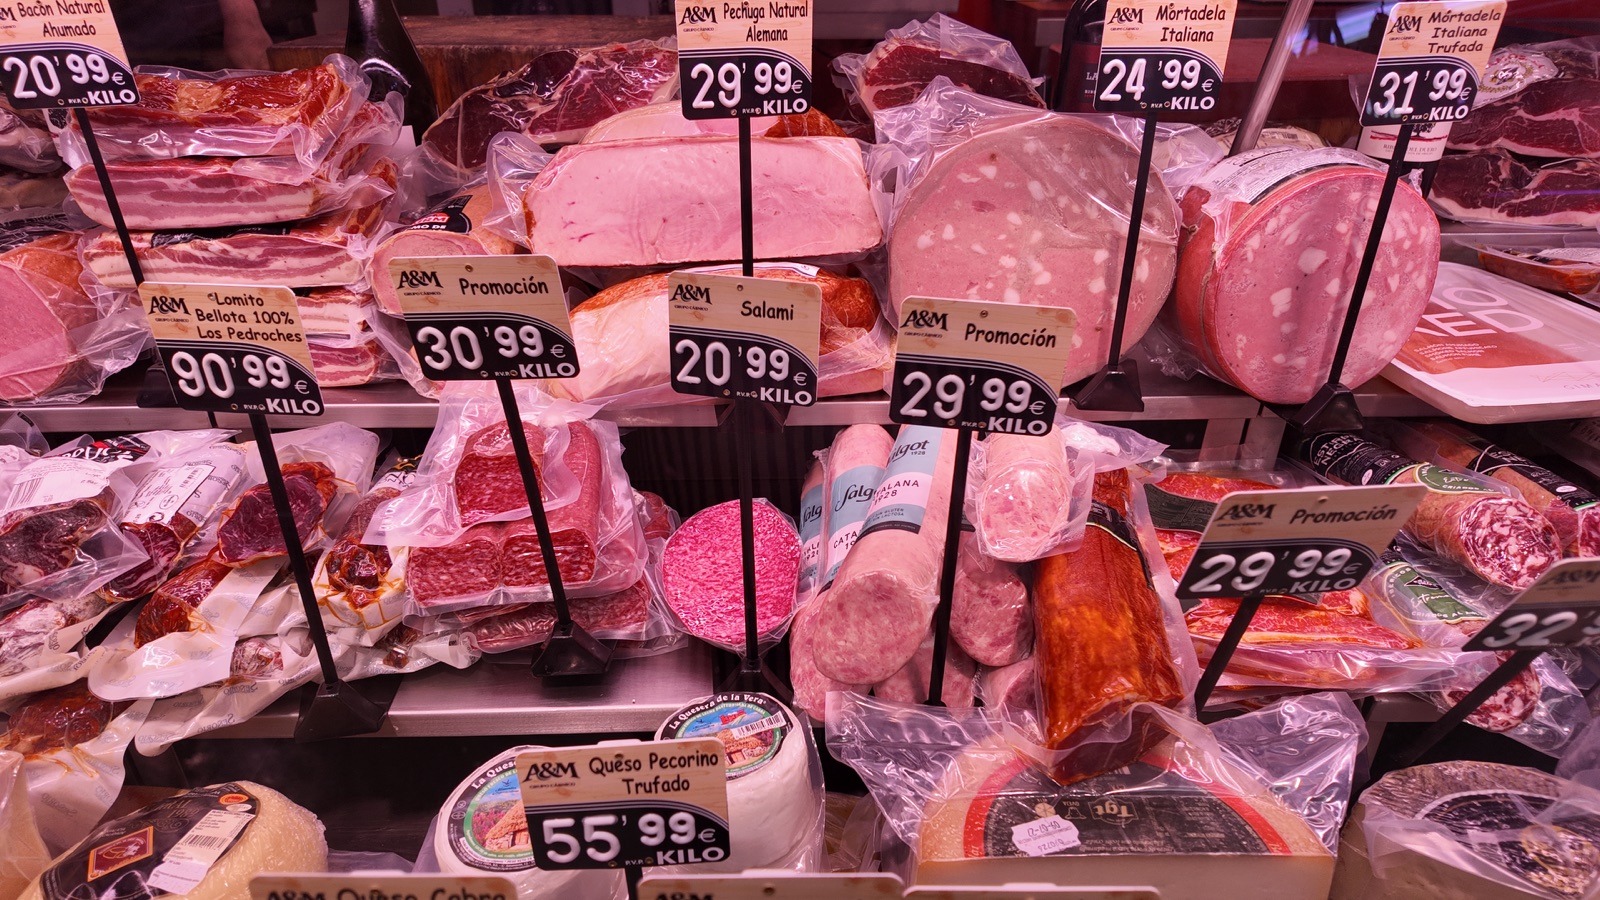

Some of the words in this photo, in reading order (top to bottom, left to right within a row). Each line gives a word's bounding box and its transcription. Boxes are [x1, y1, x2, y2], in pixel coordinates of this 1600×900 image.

[56, 0, 105, 16] Natural
[679, 6, 718, 25] A&M
[723, 3, 765, 23] Pechuga
[769, 1, 808, 18] Natural
[1107, 7, 1144, 24] A&M
[1156, 4, 1226, 21] Mortadela
[1428, 9, 1501, 24] Mortadela
[43, 20, 97, 37] Ahumado
[746, 25, 788, 42] Alemana
[1387, 15, 1423, 34] A&M
[1431, 25, 1487, 39] Italiana
[1160, 26, 1214, 42] Italiana
[1428, 41, 1483, 54] Trufada
[88, 89, 136, 105] KILO
[763, 97, 808, 114] KILO
[1170, 96, 1215, 110] KILO
[1428, 105, 1469, 121] KILO
[397, 270, 444, 290] A&M
[459, 276, 549, 296] Promoción
[215, 292, 264, 307] Lomito
[670, 284, 712, 305] A&M
[148, 295, 191, 315] A&M
[741, 301, 794, 321] Salami
[195, 309, 247, 324] Bellota
[253, 311, 294, 325] 100%
[900, 309, 949, 331] A&M
[196, 326, 222, 339] Los
[227, 327, 303, 343] Pedroches
[964, 323, 1057, 348] Promoción
[519, 362, 576, 378] KILO
[760, 386, 812, 405] KILO
[265, 398, 320, 415] KILO
[988, 416, 1048, 435] KILO
[1213, 503, 1277, 521] A&M
[1289, 504, 1397, 525] Promoción
[1289, 577, 1357, 594] KILO
[669, 720, 681, 730] La
[678, 701, 715, 720] Quesera
[716, 694, 728, 702] de
[523, 761, 580, 783] A&M
[589, 757, 641, 776] Queso
[650, 750, 718, 769] Pecorino
[471, 778, 486, 789] La
[487, 761, 517, 778] Ques
[622, 775, 690, 795] Trufado
[656, 847, 725, 865] KILO
